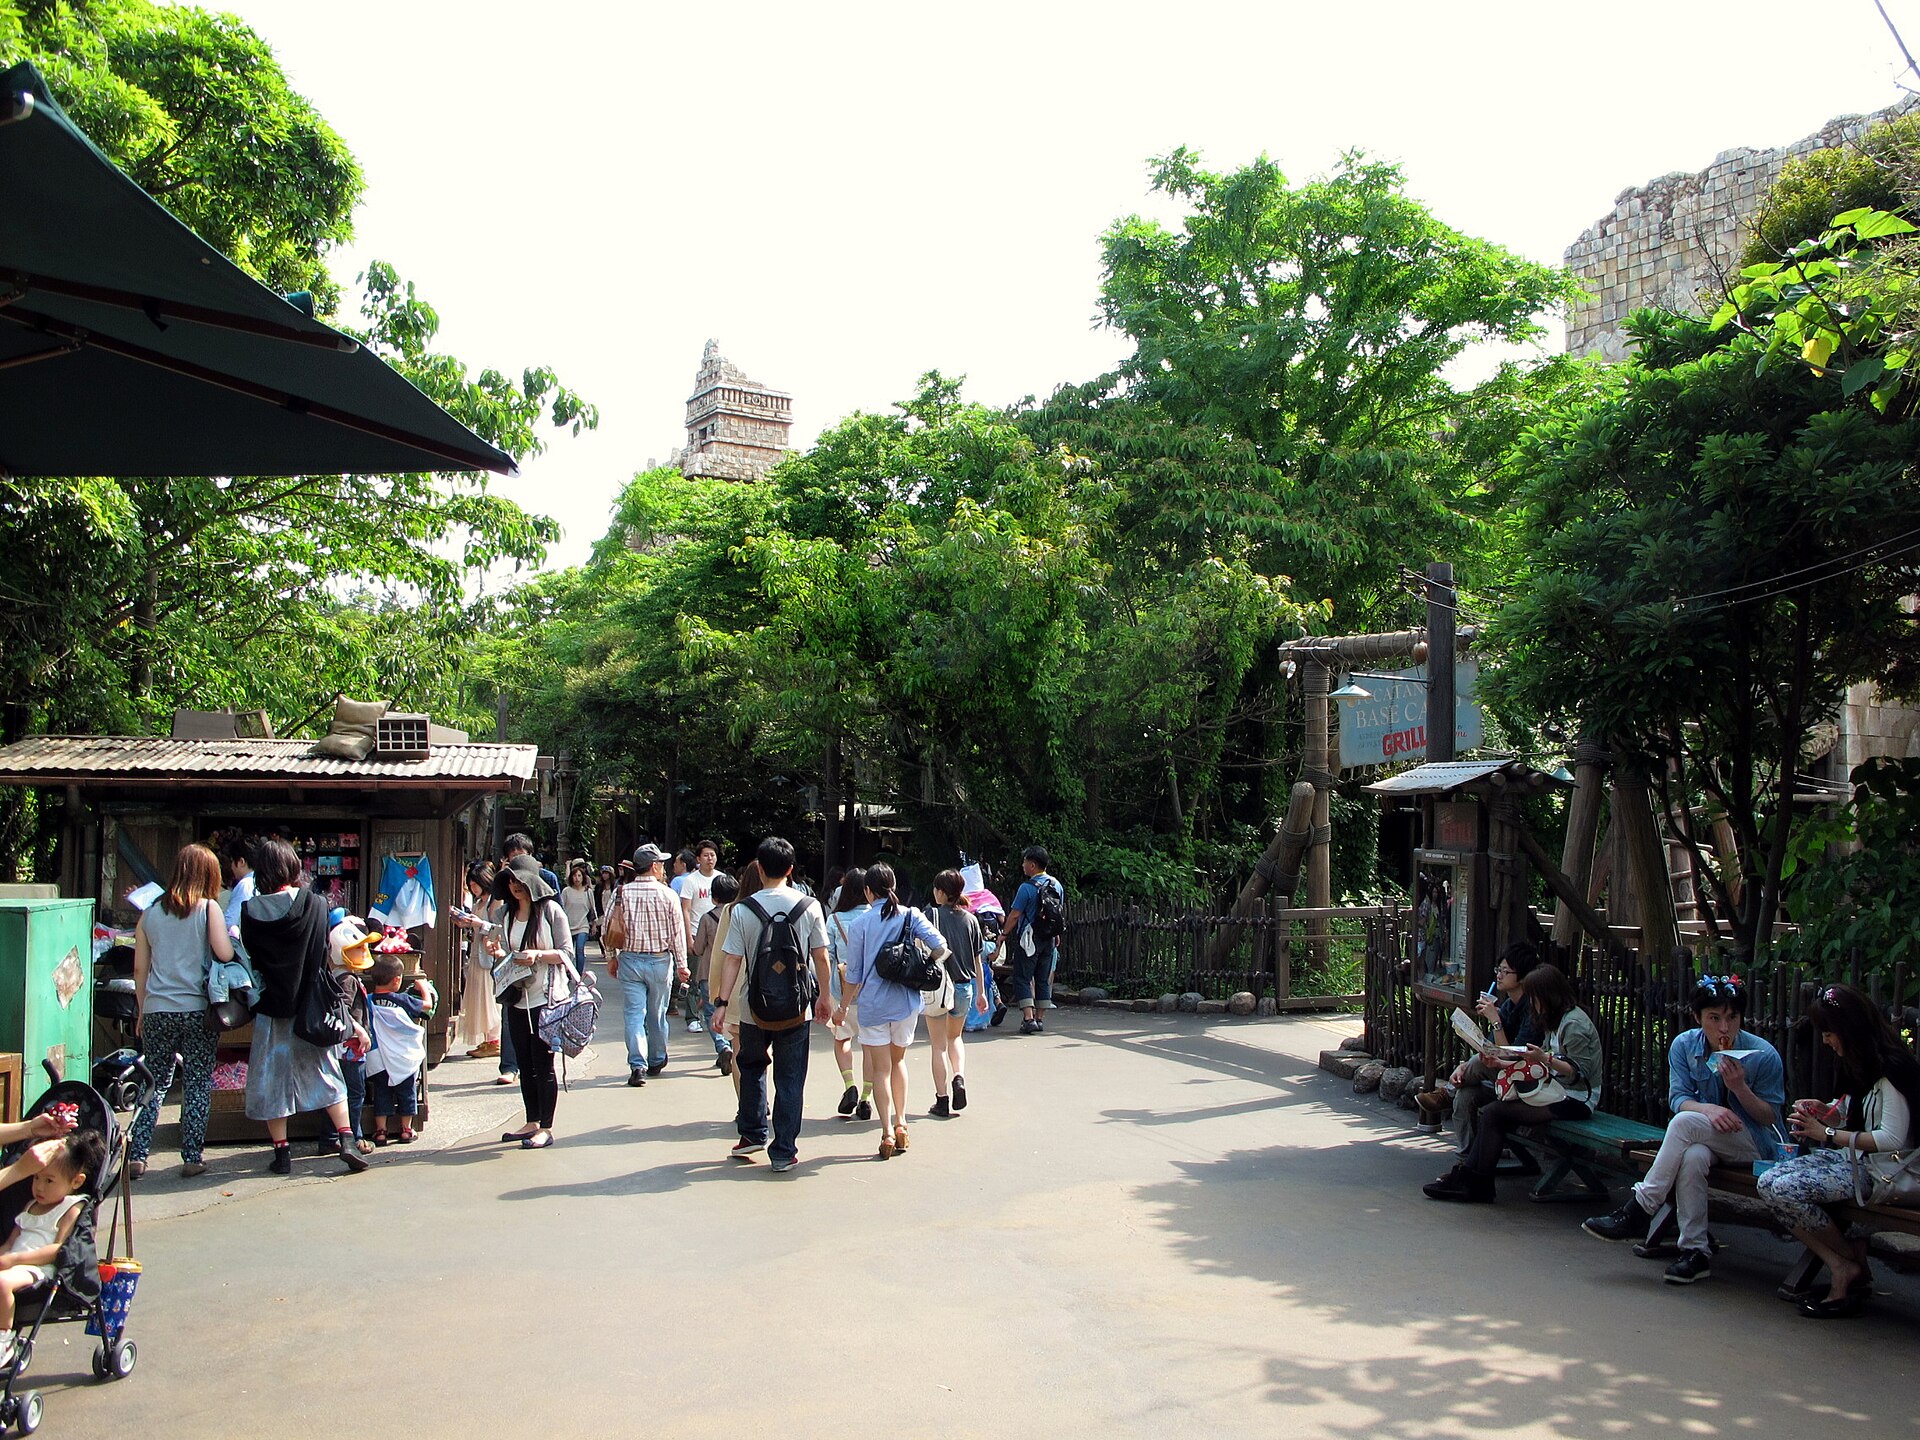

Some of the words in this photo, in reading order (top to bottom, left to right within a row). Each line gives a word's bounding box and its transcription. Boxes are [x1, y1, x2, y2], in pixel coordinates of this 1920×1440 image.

[1357, 682, 1427, 706] CATAN
[1356, 704, 1400, 729] BASE
[1383, 725, 1428, 756] GRILL
